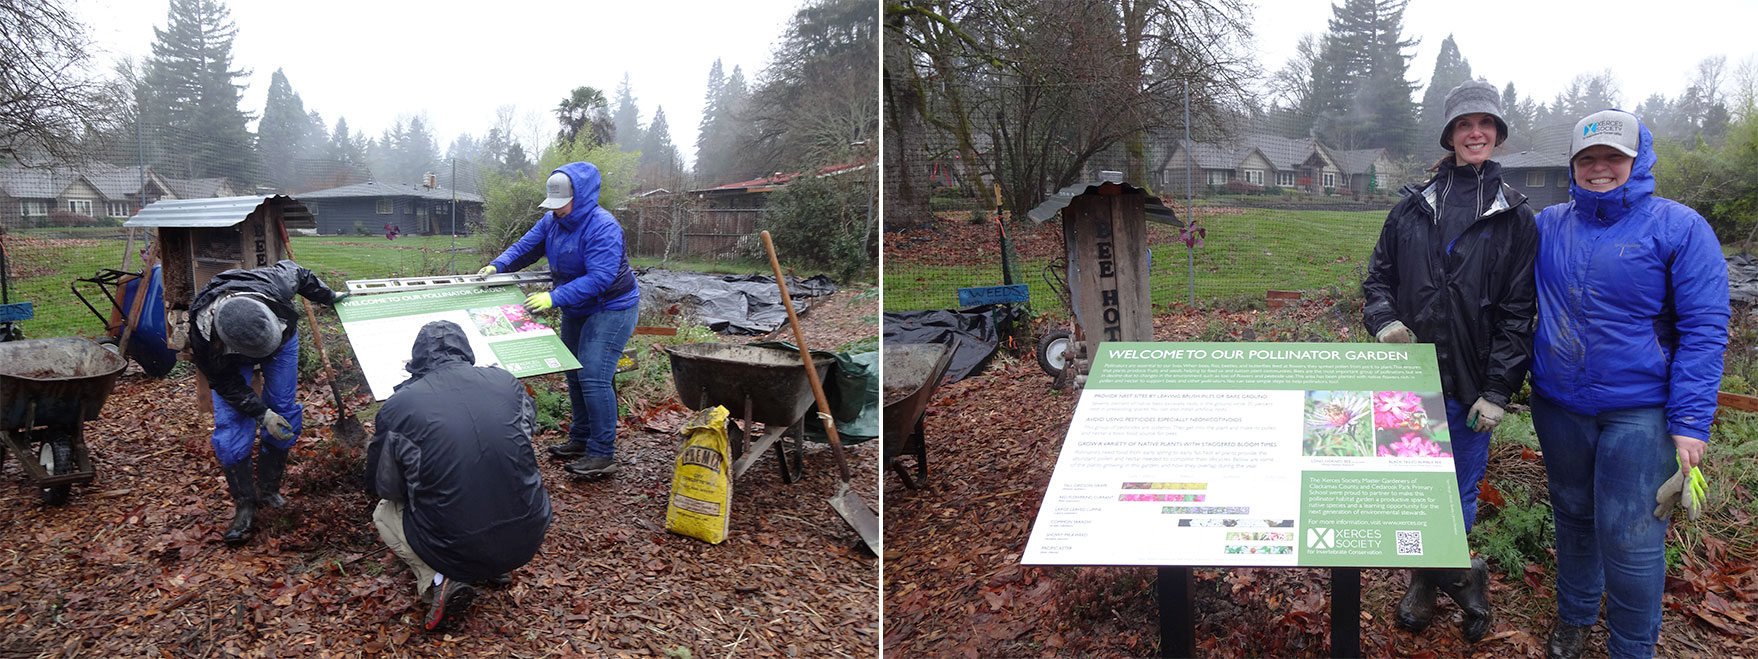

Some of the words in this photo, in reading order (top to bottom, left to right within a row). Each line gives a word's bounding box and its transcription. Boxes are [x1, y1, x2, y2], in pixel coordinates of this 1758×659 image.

[1096, 220, 1114, 278] BEE
[342, 297, 388, 308] WELCOME
[423, 288, 472, 299] POLLINATOR
[474, 286, 506, 295] GARDEN
[969, 286, 1021, 298] WEEDS
[1108, 350, 1184, 360] WELCOME
[1186, 350, 1207, 360] TO
[1211, 350, 1244, 360] OUR
[1249, 350, 1341, 360] POLLINATOR
[1345, 350, 1408, 360] GARDEN
[1336, 529, 1382, 538] XERCES
[1336, 540, 1382, 548] SOCIETY
